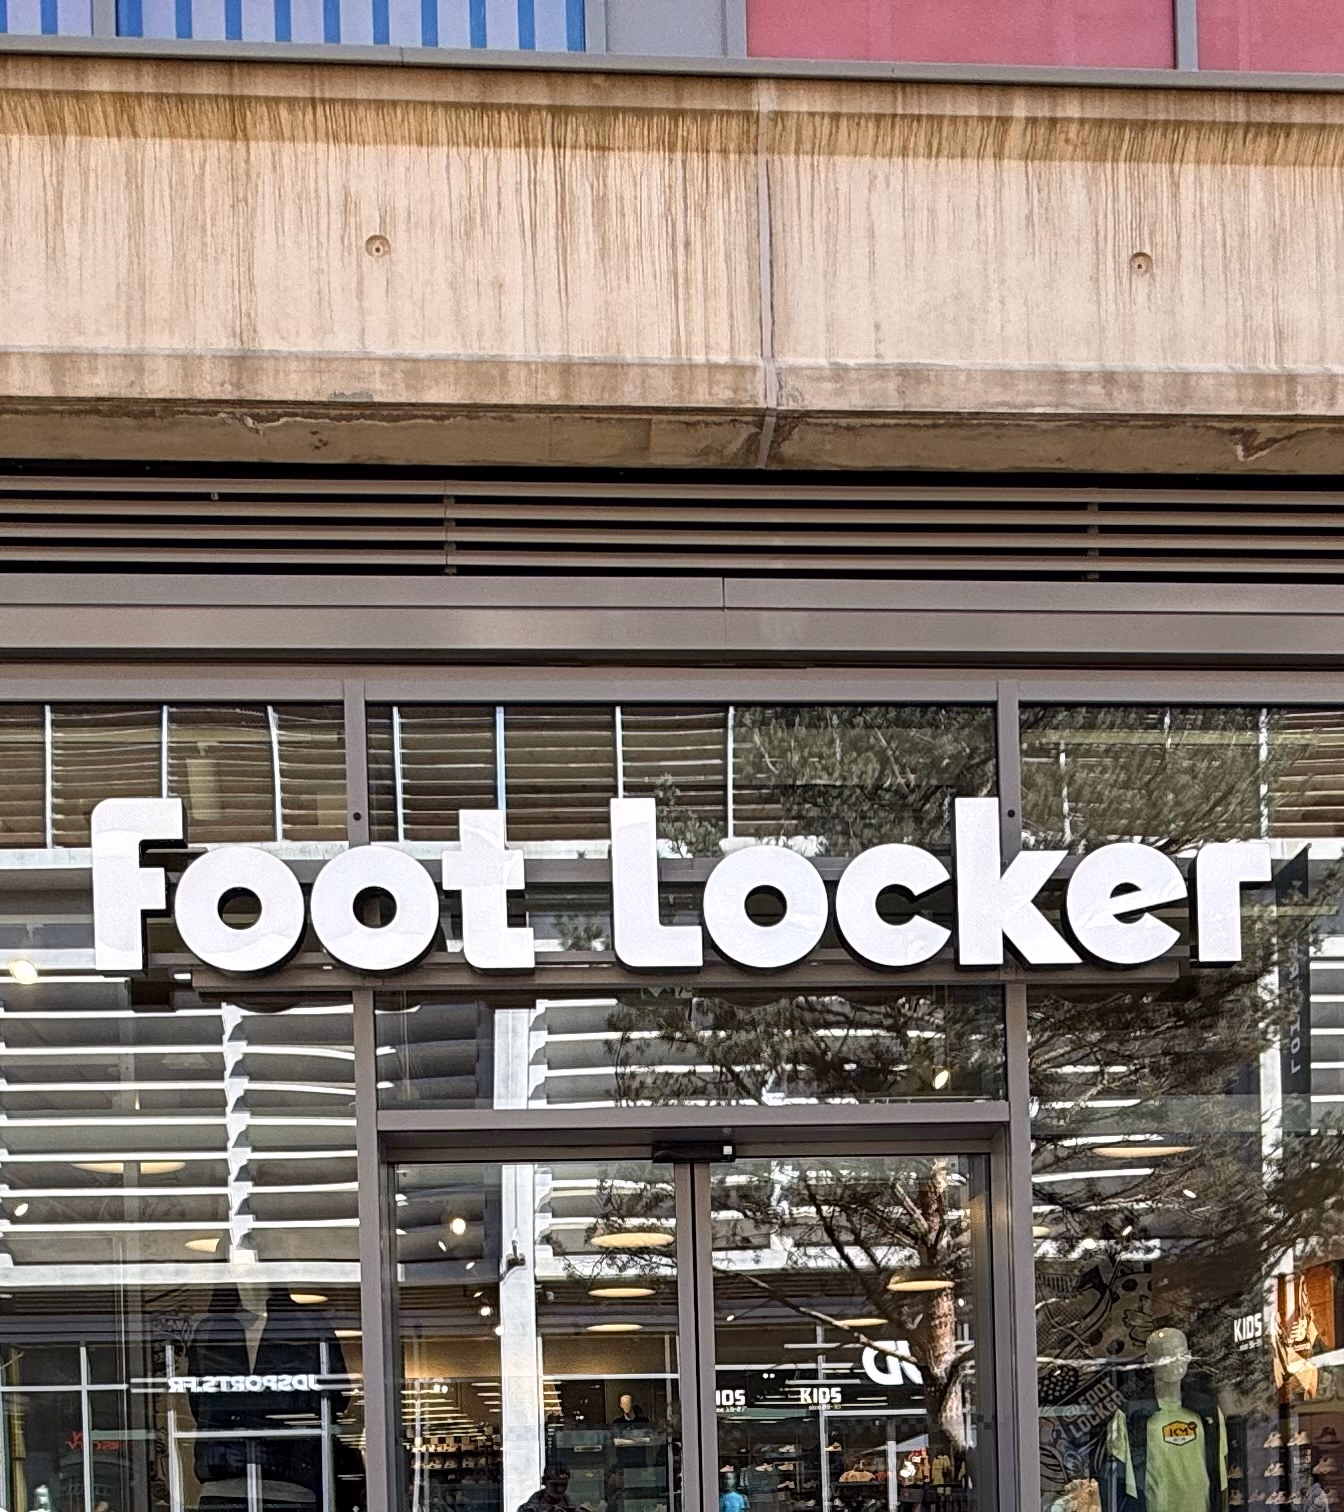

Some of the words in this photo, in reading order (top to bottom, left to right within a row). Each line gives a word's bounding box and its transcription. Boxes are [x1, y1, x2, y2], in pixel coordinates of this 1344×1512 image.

[610, 797, 1272, 968] Locker
[1233, 1312, 1263, 1343] KIDS
[715, 1389, 746, 1406] IDS
[800, 1387, 842, 1404] KIDS
